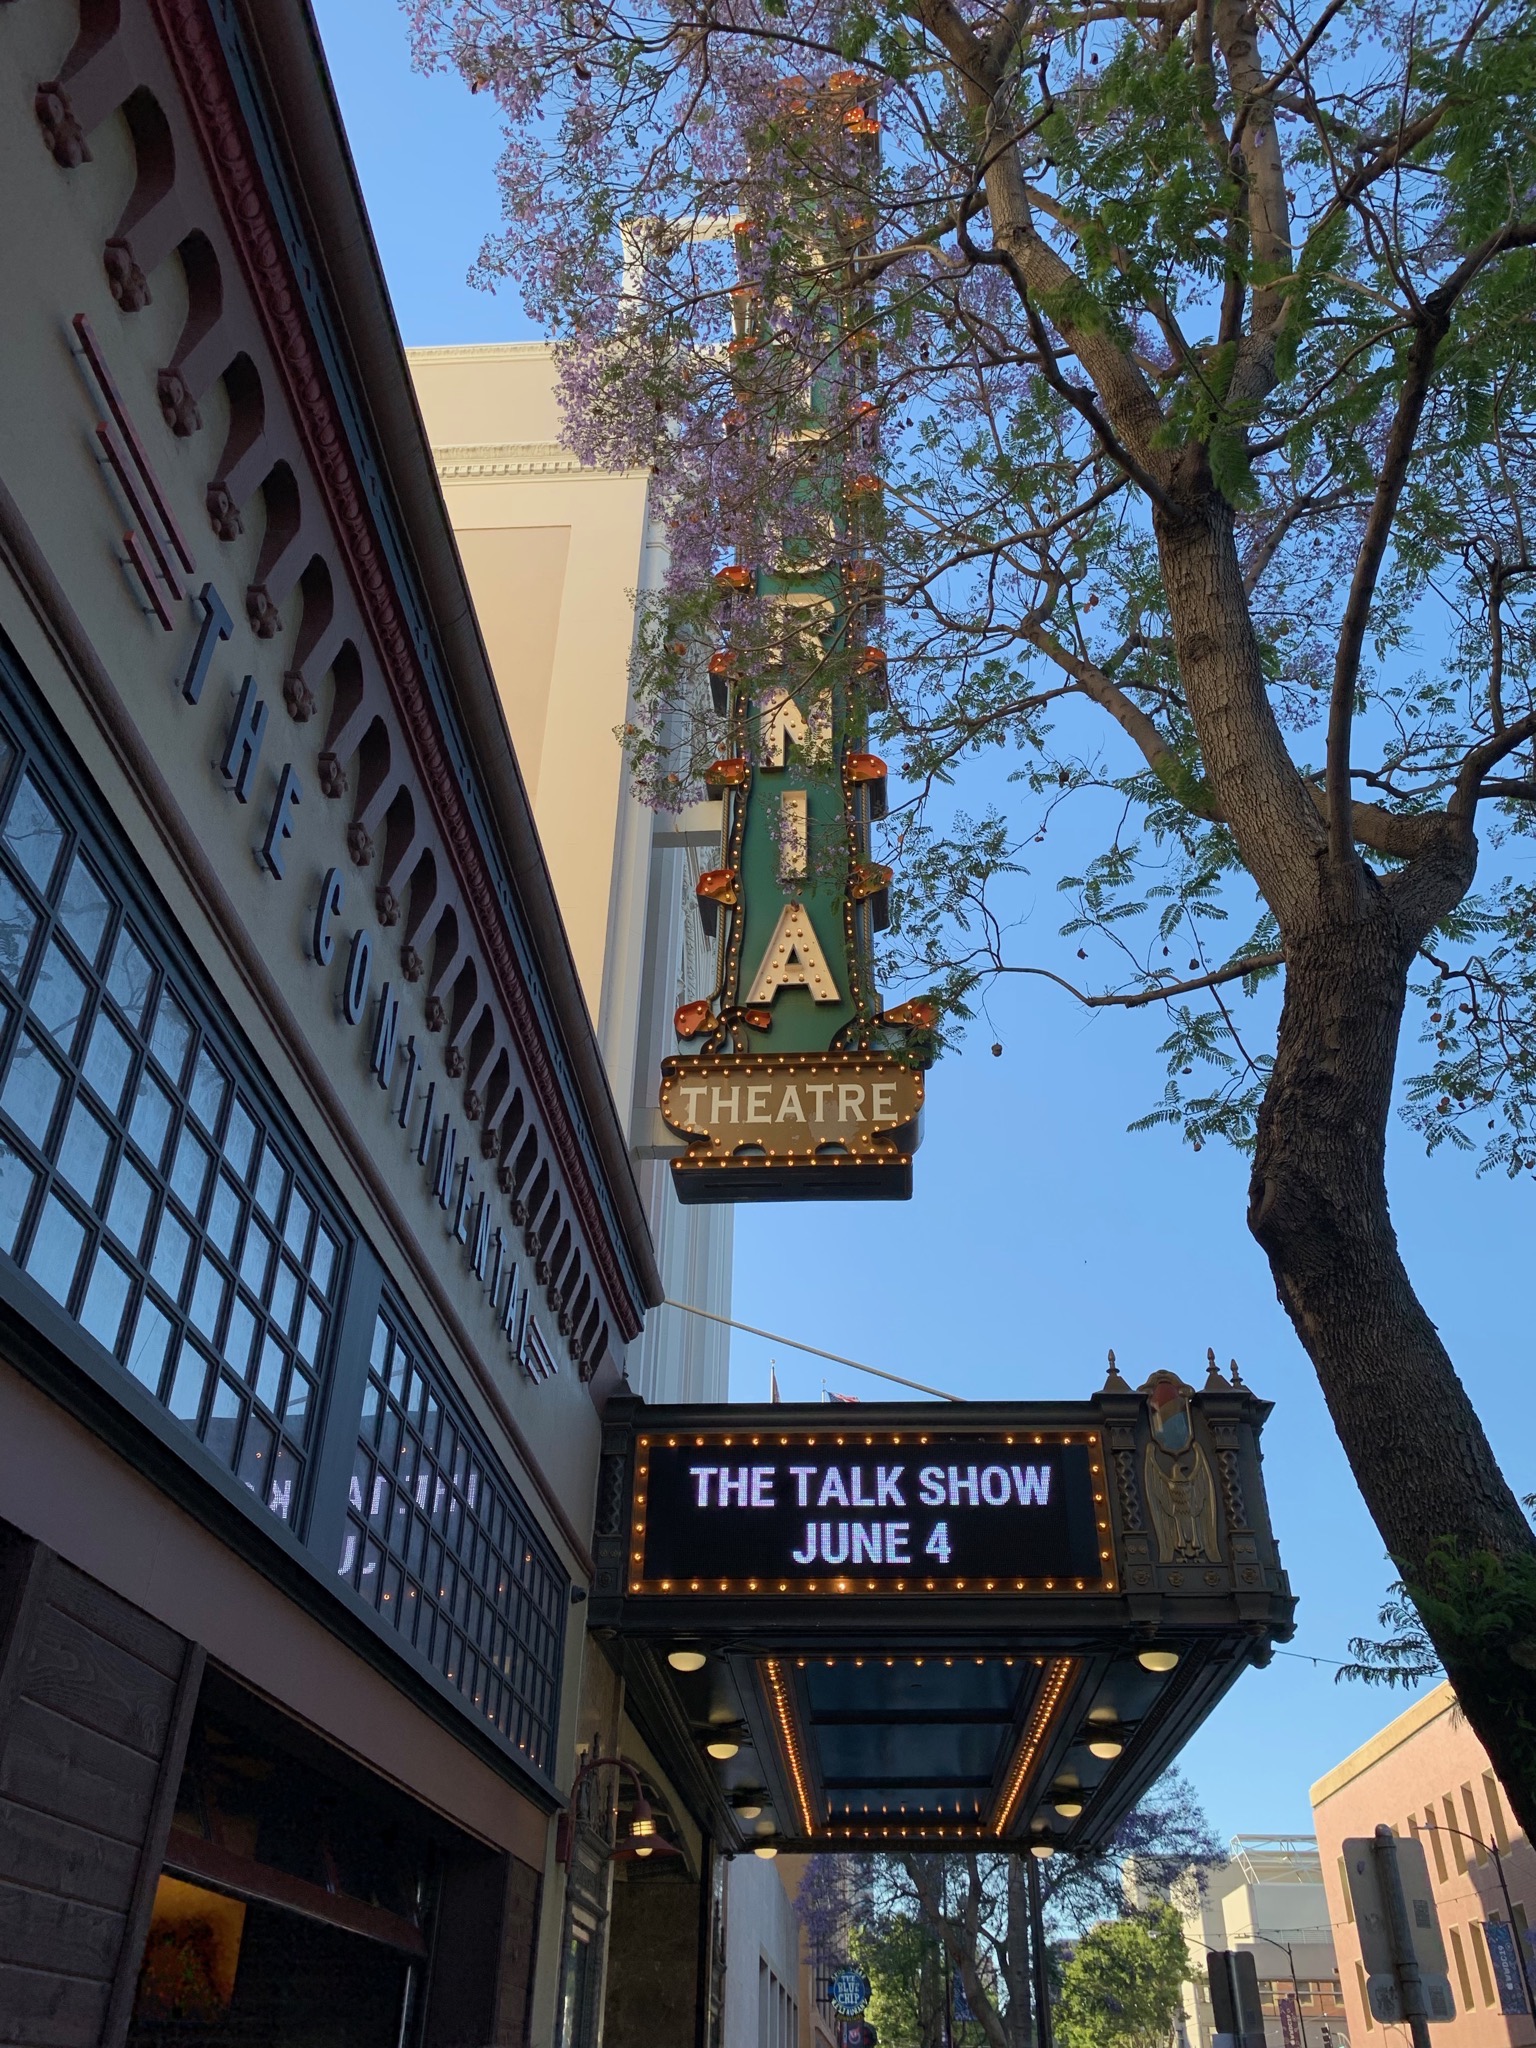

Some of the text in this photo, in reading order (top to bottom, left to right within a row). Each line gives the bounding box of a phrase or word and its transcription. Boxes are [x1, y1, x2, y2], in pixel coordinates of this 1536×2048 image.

[181, 582, 301, 881] THE
[313, 867, 531, 1366] CONTINENTAL
[679, 1081, 899, 1126] THEATRE
[690, 1465, 1052, 1508] THE TALK SHOW
[793, 1521, 952, 1564] JUNE 4
[837, 1982, 860, 1993] BLUE
[838, 1993, 860, 2005] CHIP
